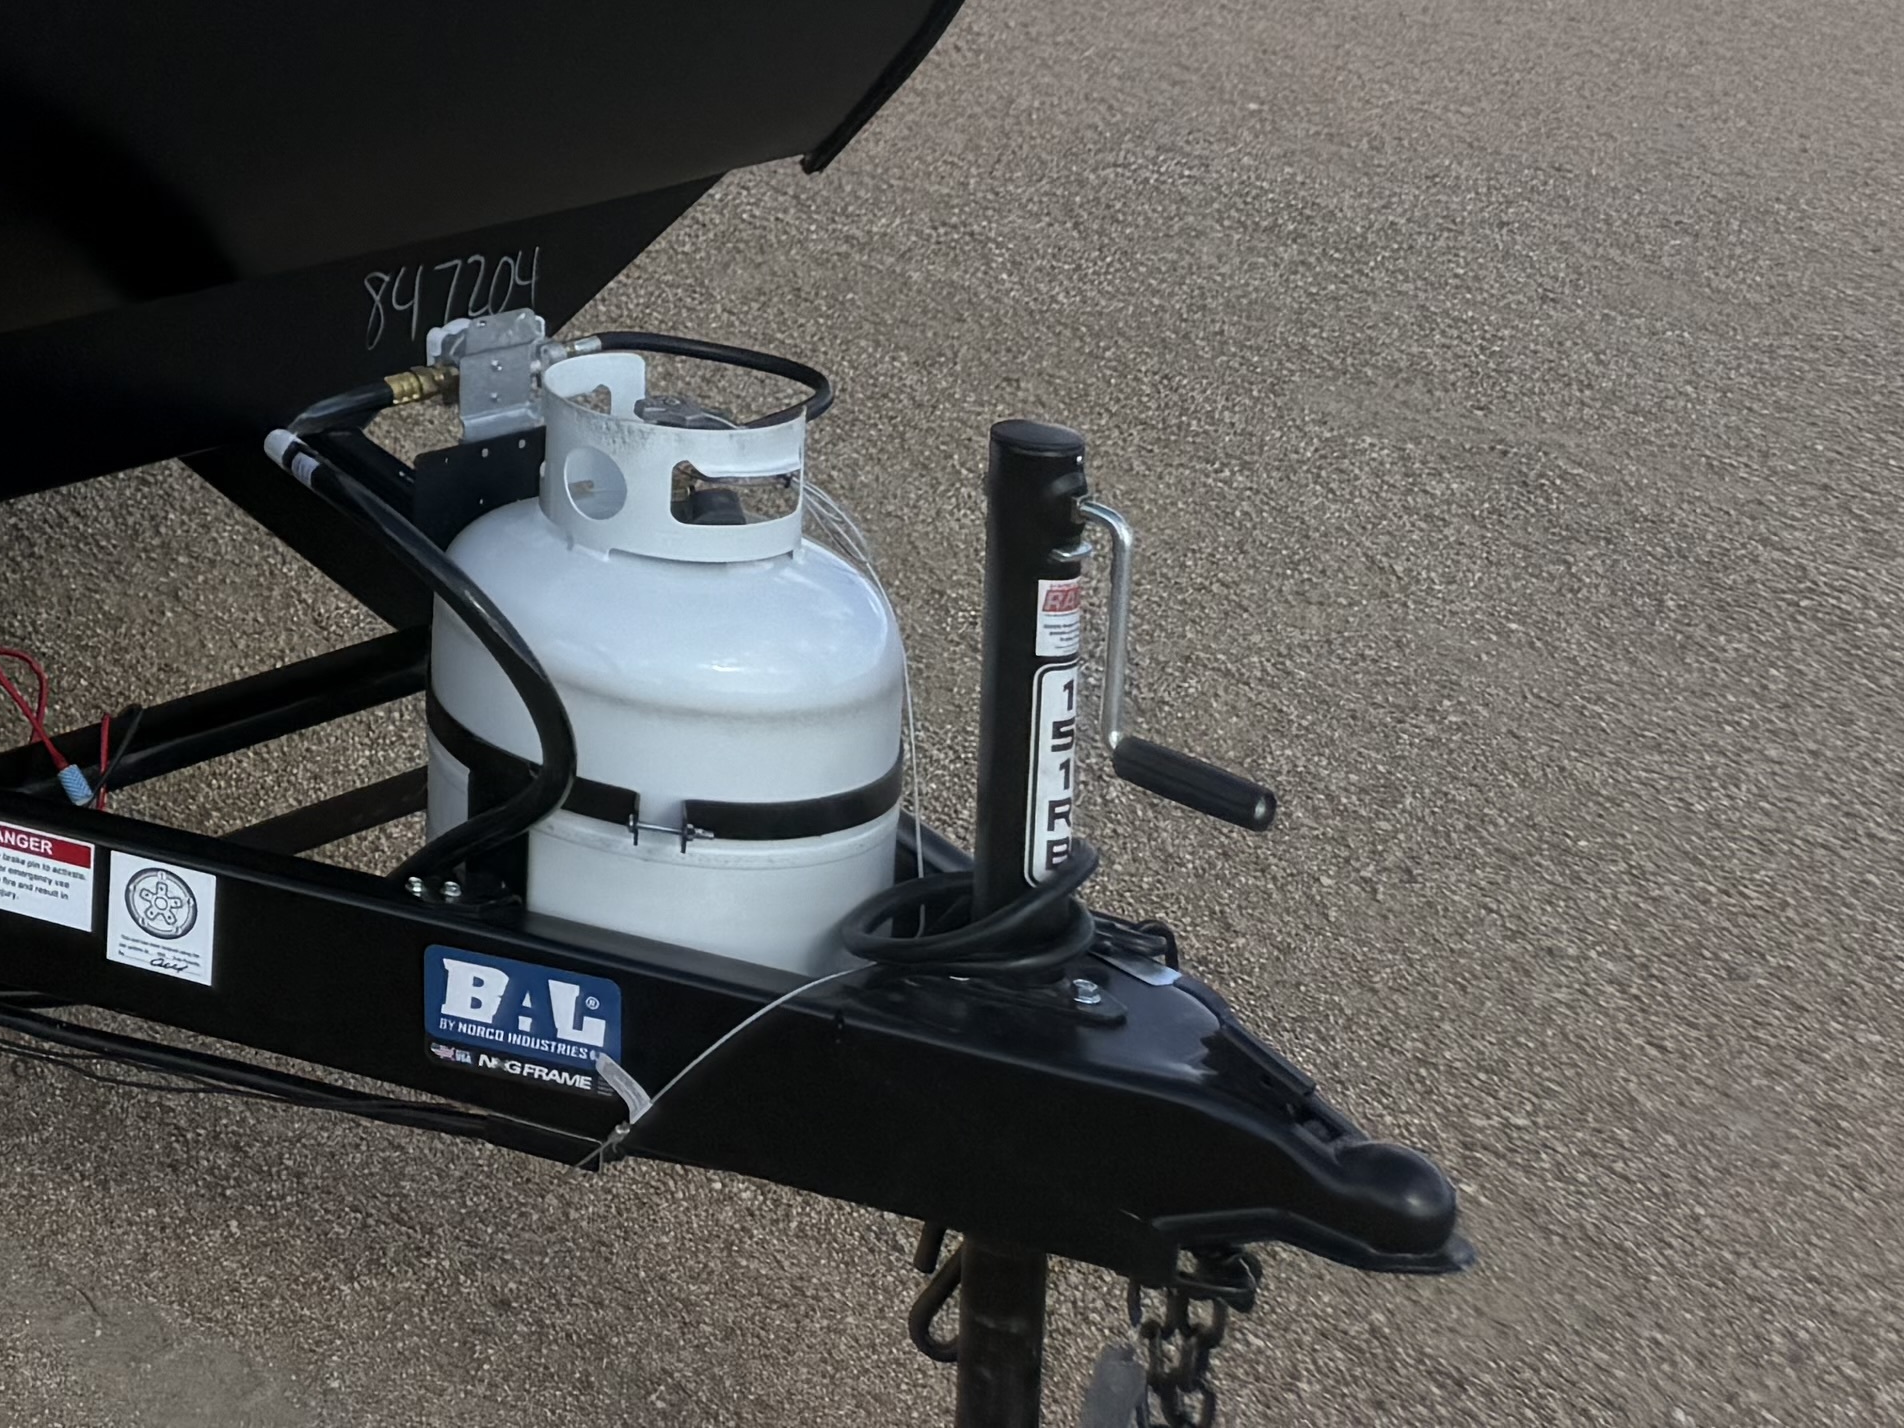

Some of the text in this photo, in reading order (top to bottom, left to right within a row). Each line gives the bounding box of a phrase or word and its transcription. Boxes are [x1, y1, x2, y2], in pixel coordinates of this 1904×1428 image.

[439, 1016, 588, 1061] BY NORCO INDUSTRIES
[523, 1064, 592, 1090] FRAME
